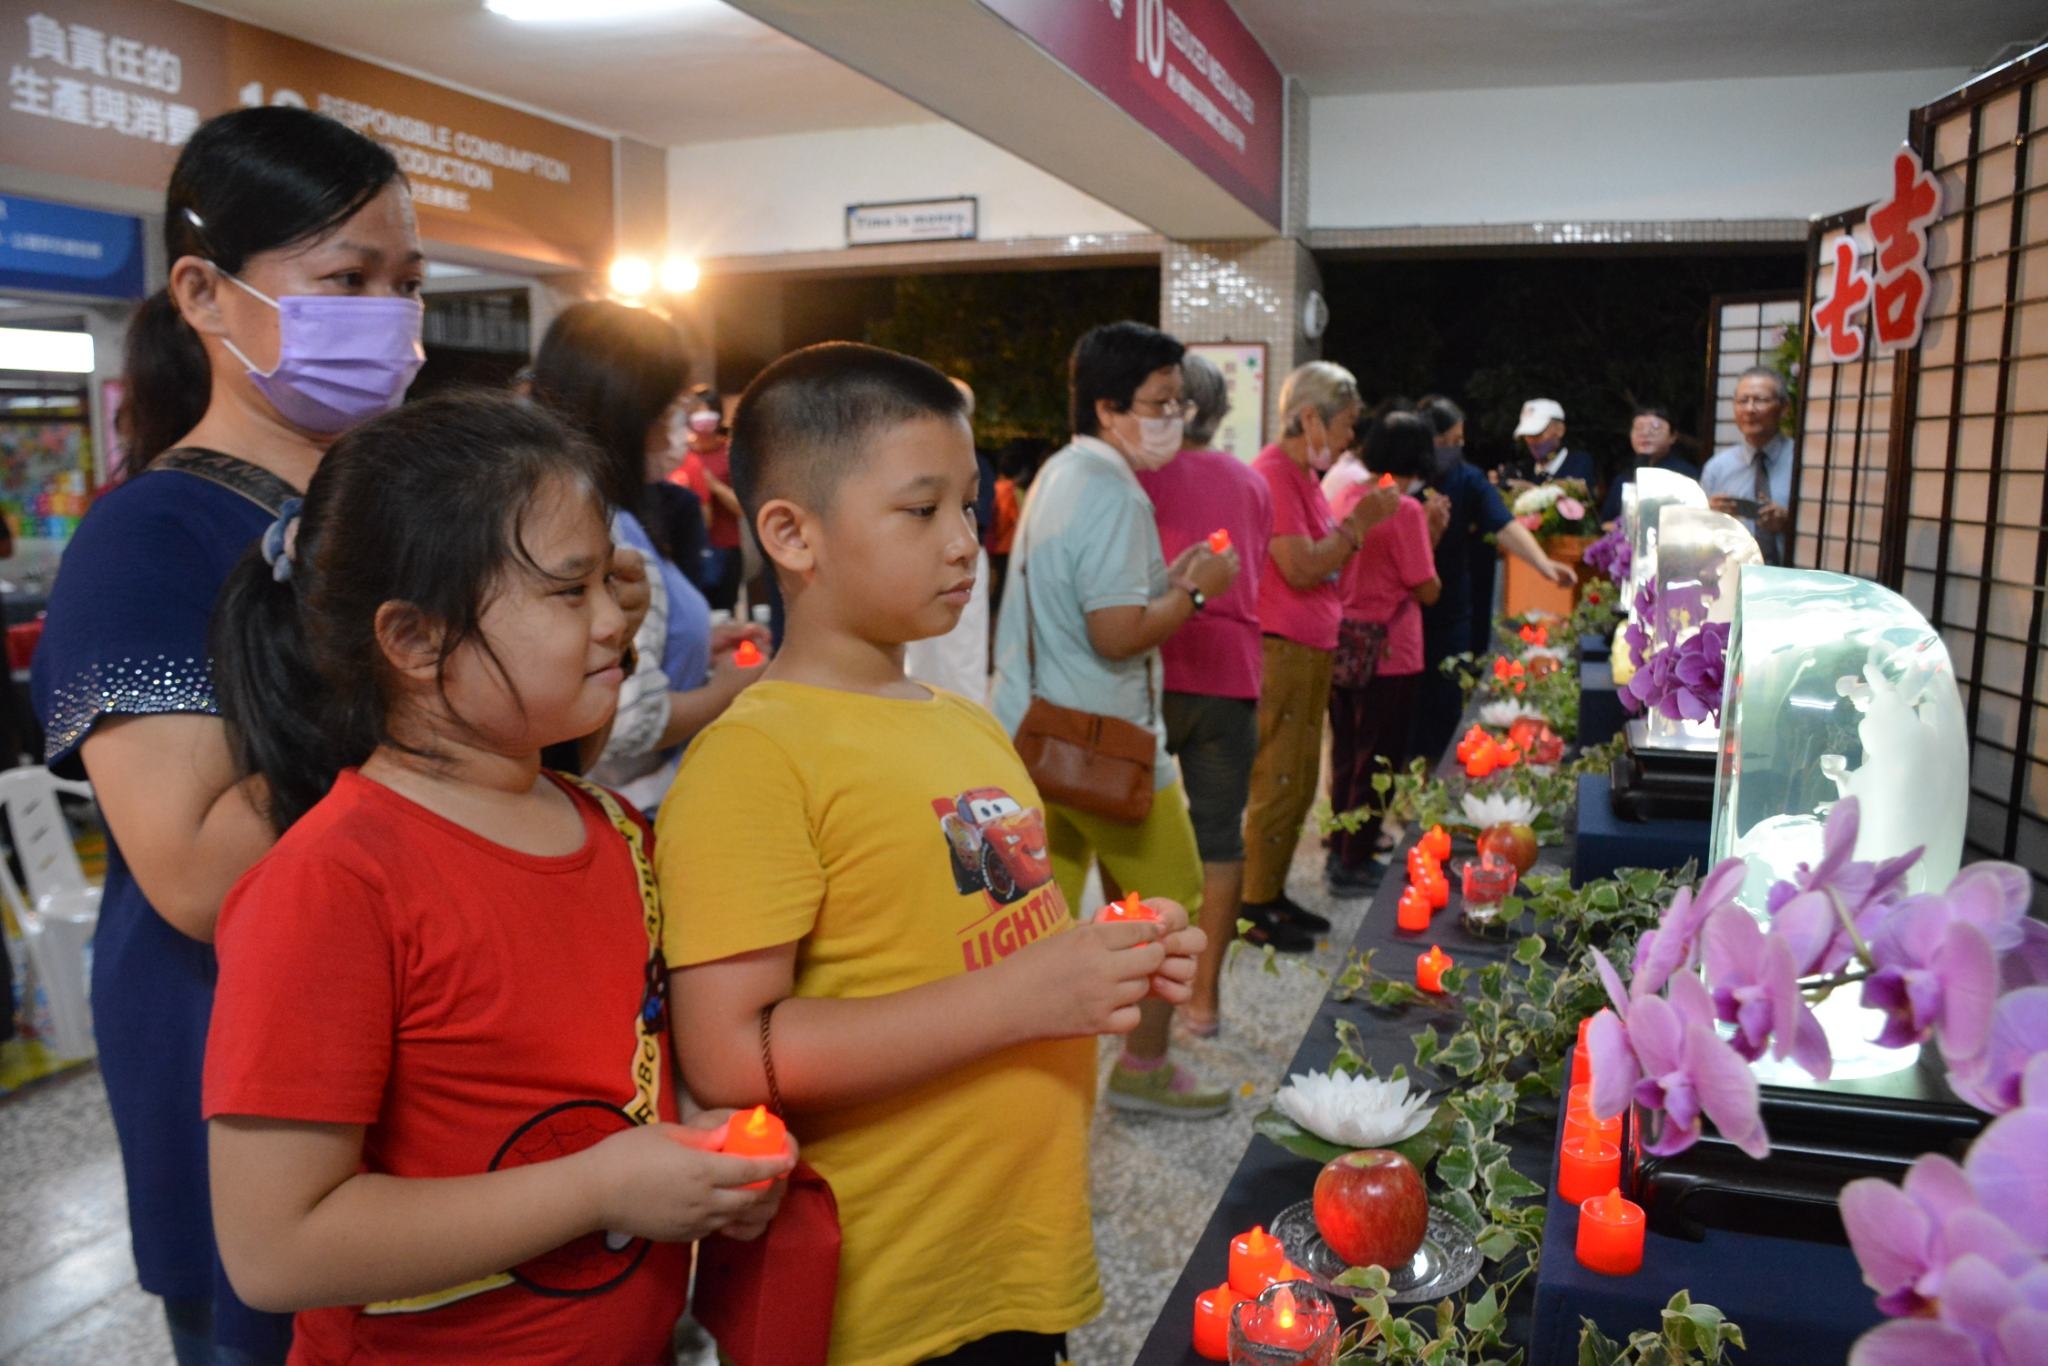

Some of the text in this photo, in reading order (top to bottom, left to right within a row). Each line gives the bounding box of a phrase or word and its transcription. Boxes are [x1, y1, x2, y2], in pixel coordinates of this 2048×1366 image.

[27, 13, 181, 95] 負責任的
[1136, 0, 1164, 78] 10
[384, 143, 494, 191] ODUCTION
[454, 131, 571, 184] CONSUMPTION
[1869, 151, 1937, 344] 吉
[1815, 242, 1869, 358] 七
